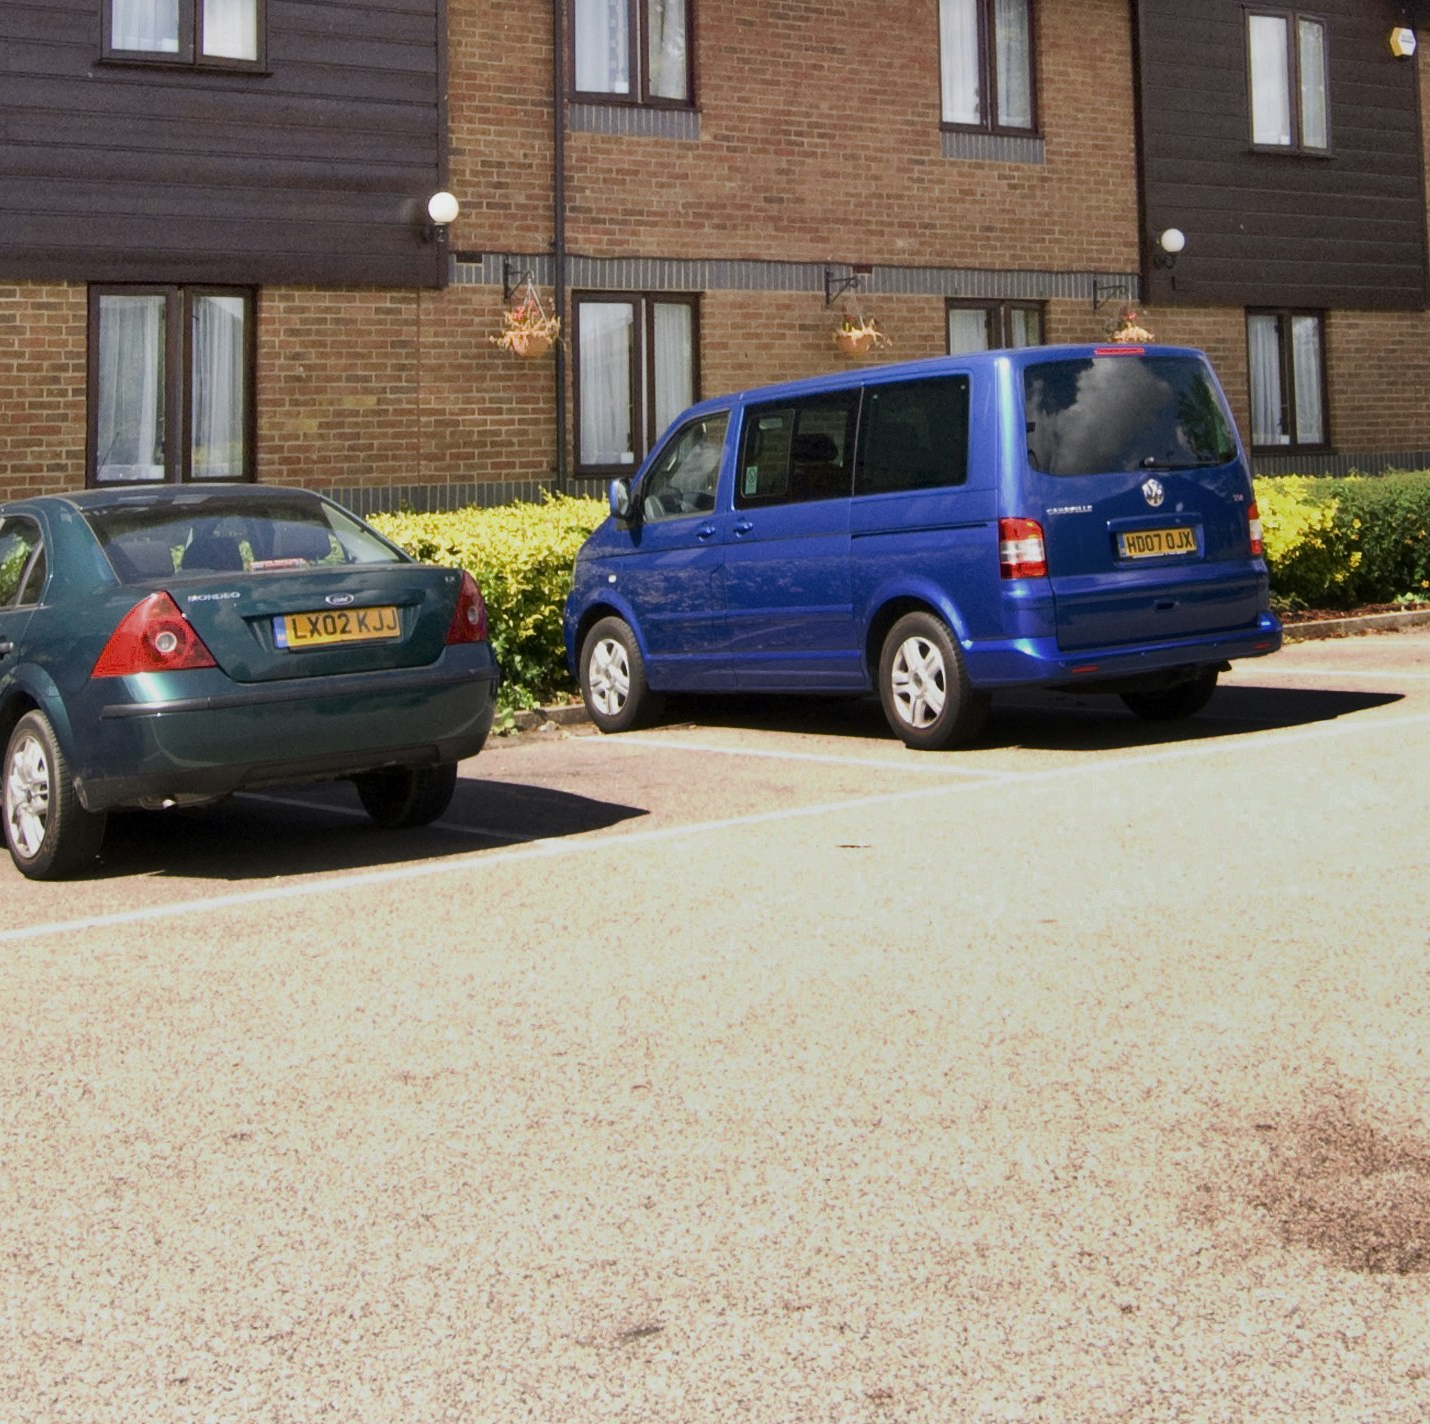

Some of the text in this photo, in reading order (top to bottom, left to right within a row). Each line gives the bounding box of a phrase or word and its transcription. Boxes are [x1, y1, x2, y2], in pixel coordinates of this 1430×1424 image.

[1126, 531, 1192, 553] HD07 OJX
[291, 609, 398, 639] LX02 KJJ
